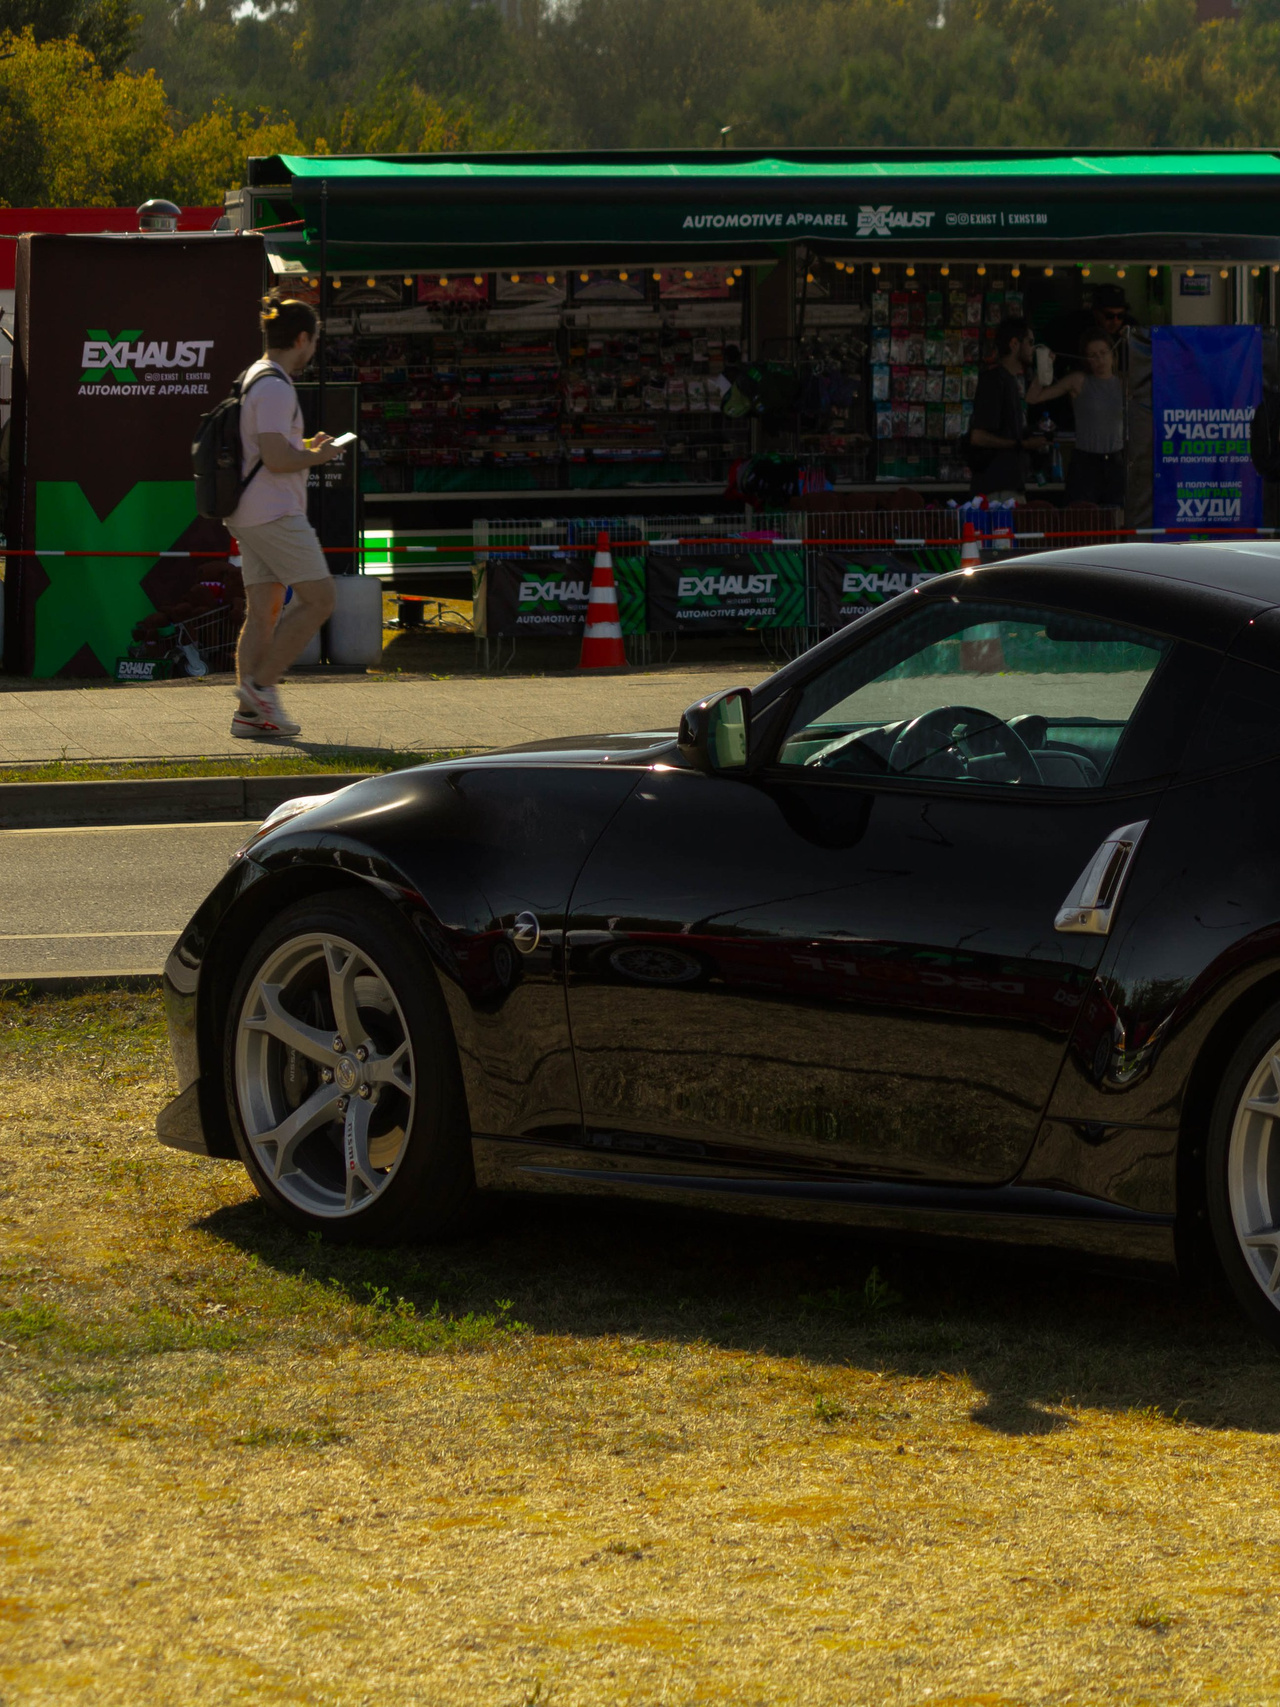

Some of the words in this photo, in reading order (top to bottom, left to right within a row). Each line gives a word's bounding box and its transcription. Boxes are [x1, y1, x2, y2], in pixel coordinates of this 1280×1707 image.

[682, 213, 783, 229] AUTOMOTIVE
[785, 212, 848, 227] APPAREL
[856, 205, 935, 236] EXHAUST
[970, 213, 997, 225] EXHST
[1008, 213, 1048, 225] EXHST.RU
[81, 340, 214, 369] EXHAUST
[78, 385, 155, 396] AUTOMOTIVE
[158, 384, 209, 395] APPAREL
[1163, 406, 1256, 422] ПРИНИМАЙ
[1162, 441, 1174, 454] В
[1176, 499, 1241, 517] ХУДИ
[678, 574, 778, 597] EXHAUST
[516, 615, 576, 624] AUTOMOTIVE
[676, 609, 736, 619] AUTOMOTIVE
[737, 607, 777, 617] APPAREL
[119, 661, 156, 675] EXHAUST
